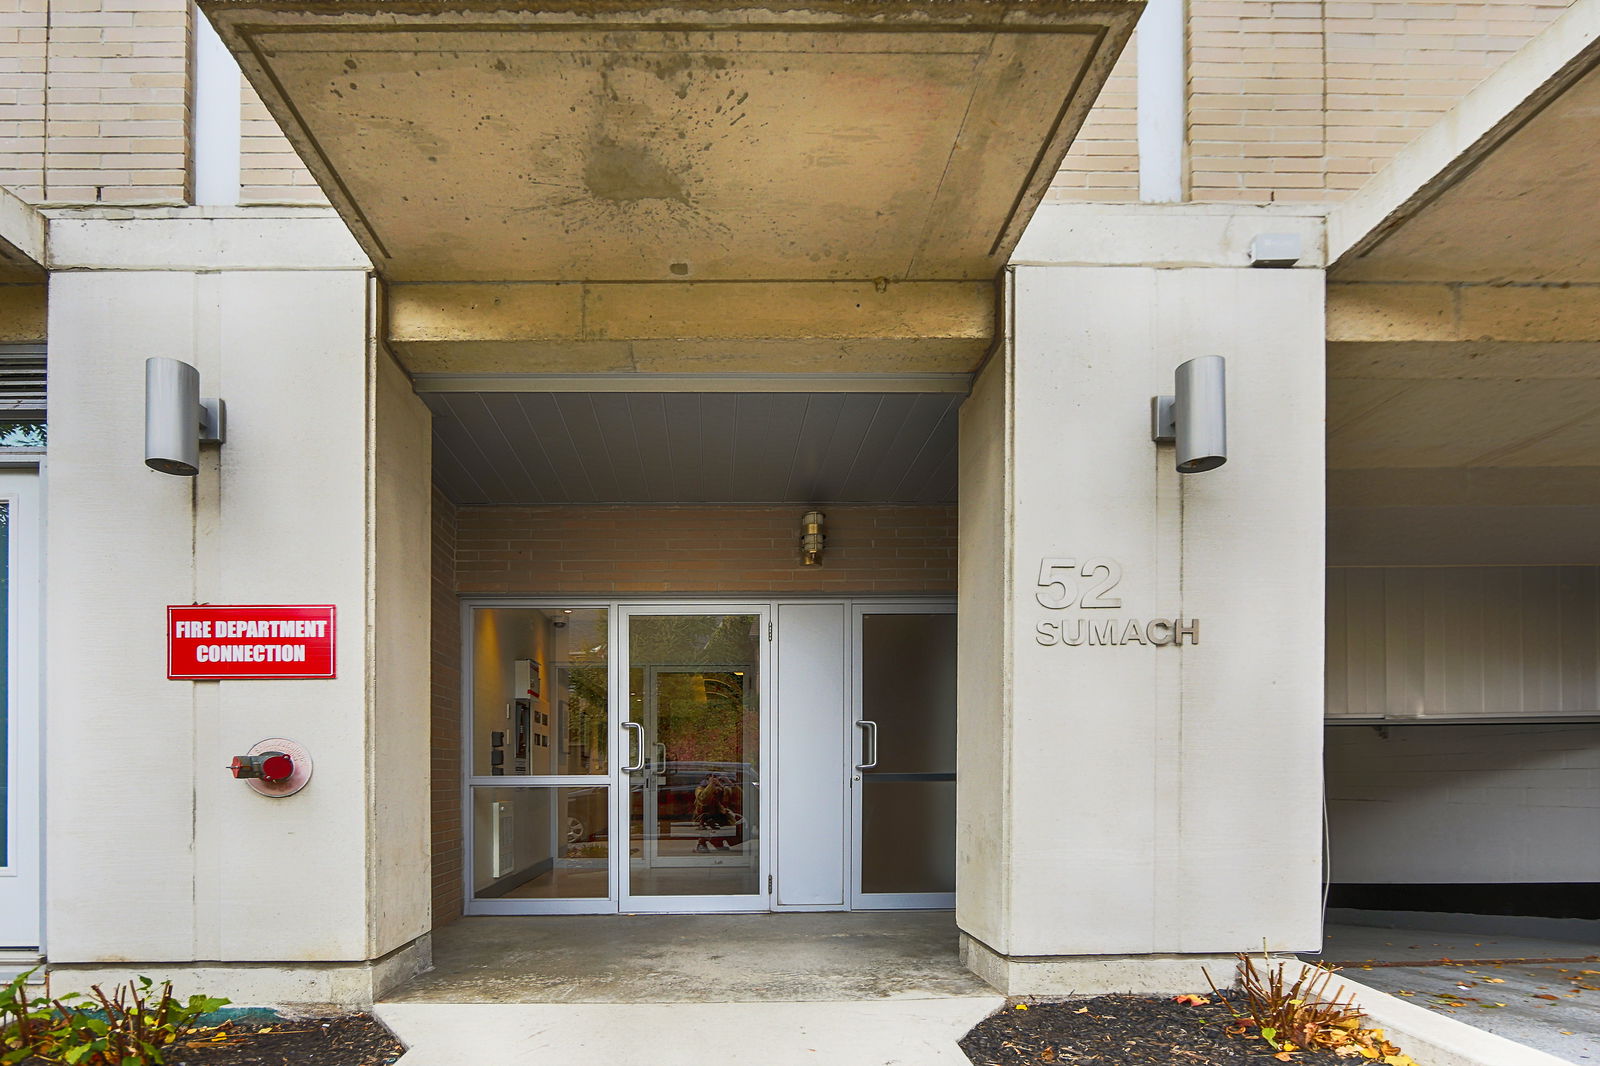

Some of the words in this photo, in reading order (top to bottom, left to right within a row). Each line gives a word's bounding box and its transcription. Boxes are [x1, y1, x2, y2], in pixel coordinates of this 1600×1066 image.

[1036, 557, 1122, 609] 52
[175, 621, 212, 638] FIRE
[215, 620, 327, 638] DEPARTMENT
[1036, 618, 1199, 646] SUMACH
[196, 645, 305, 662] CONNECTION
